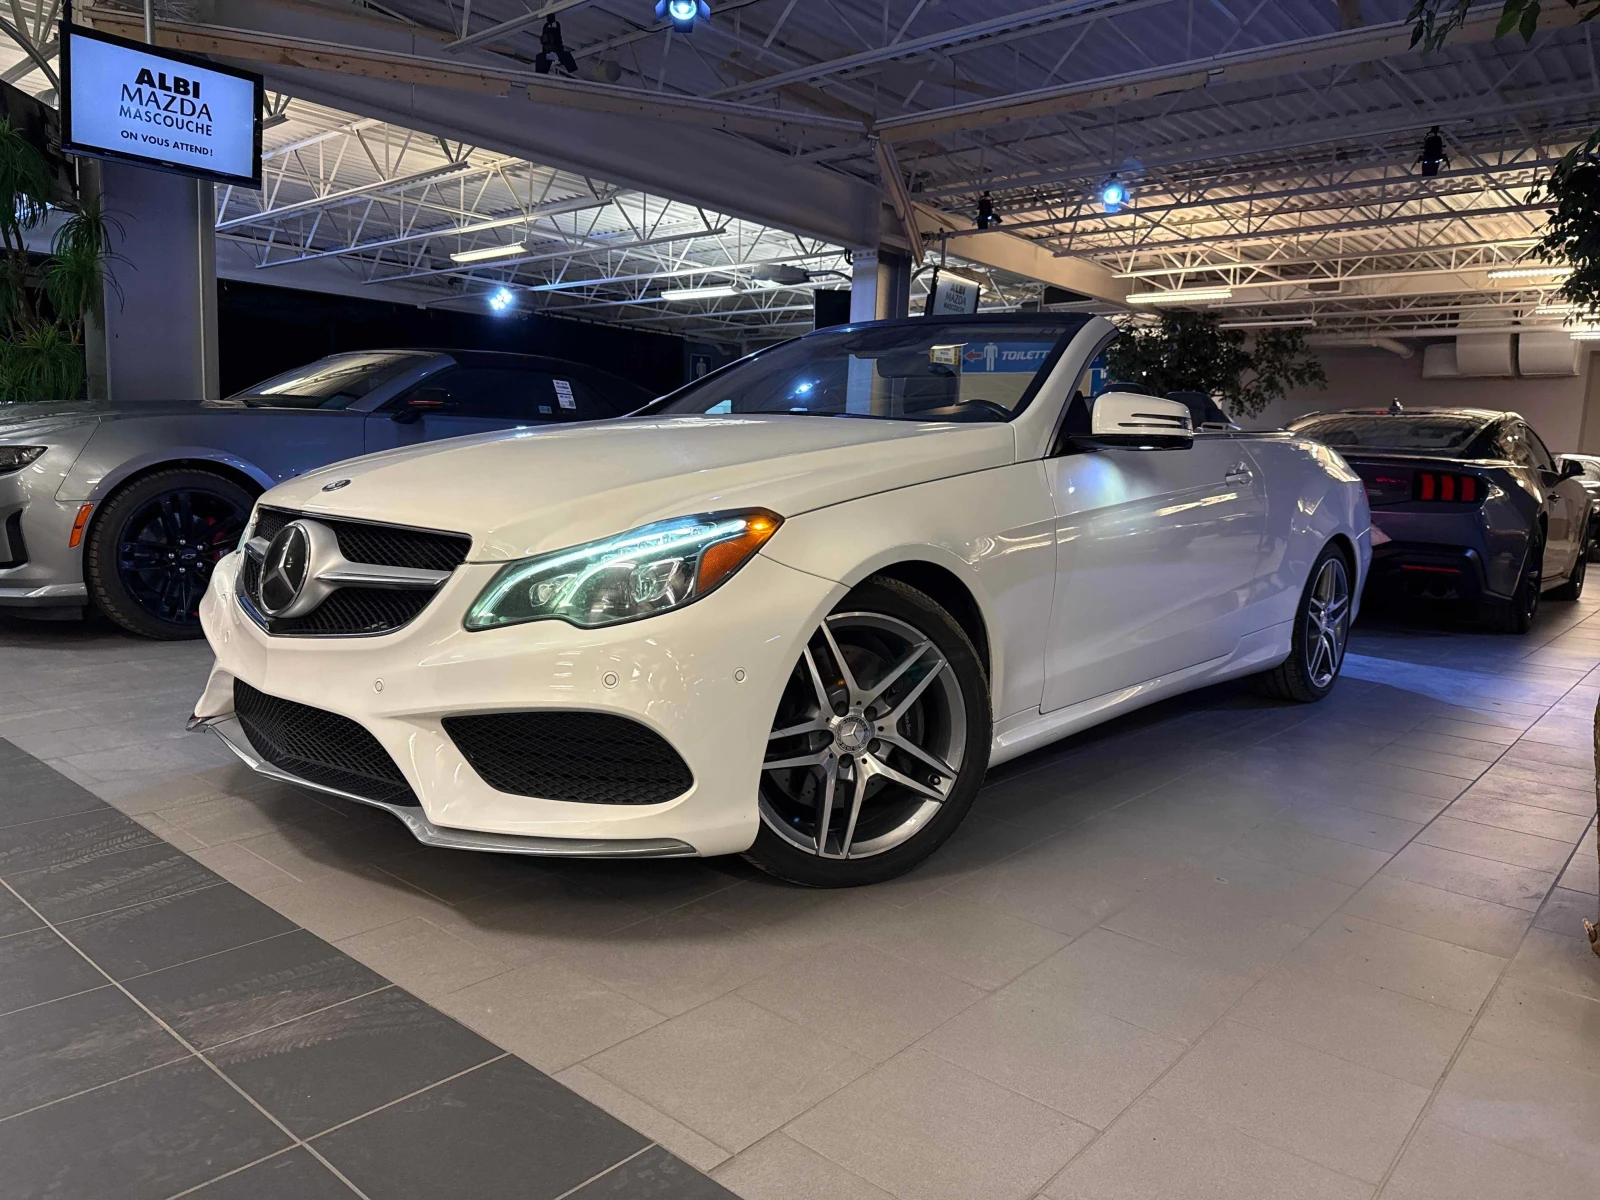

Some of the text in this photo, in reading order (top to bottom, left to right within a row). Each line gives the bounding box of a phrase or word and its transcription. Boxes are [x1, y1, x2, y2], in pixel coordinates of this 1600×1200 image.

[134, 67, 201, 100] ALBI
[120, 83, 213, 122] MAZDA
[119, 104, 213, 137] MASCOUCHE
[120, 129, 213, 157] ON VOUS ATTEND!
[945, 292, 967, 306] MAZDA
[950, 283, 966, 295] ALBI
[1002, 350, 1051, 361] TOILETT
